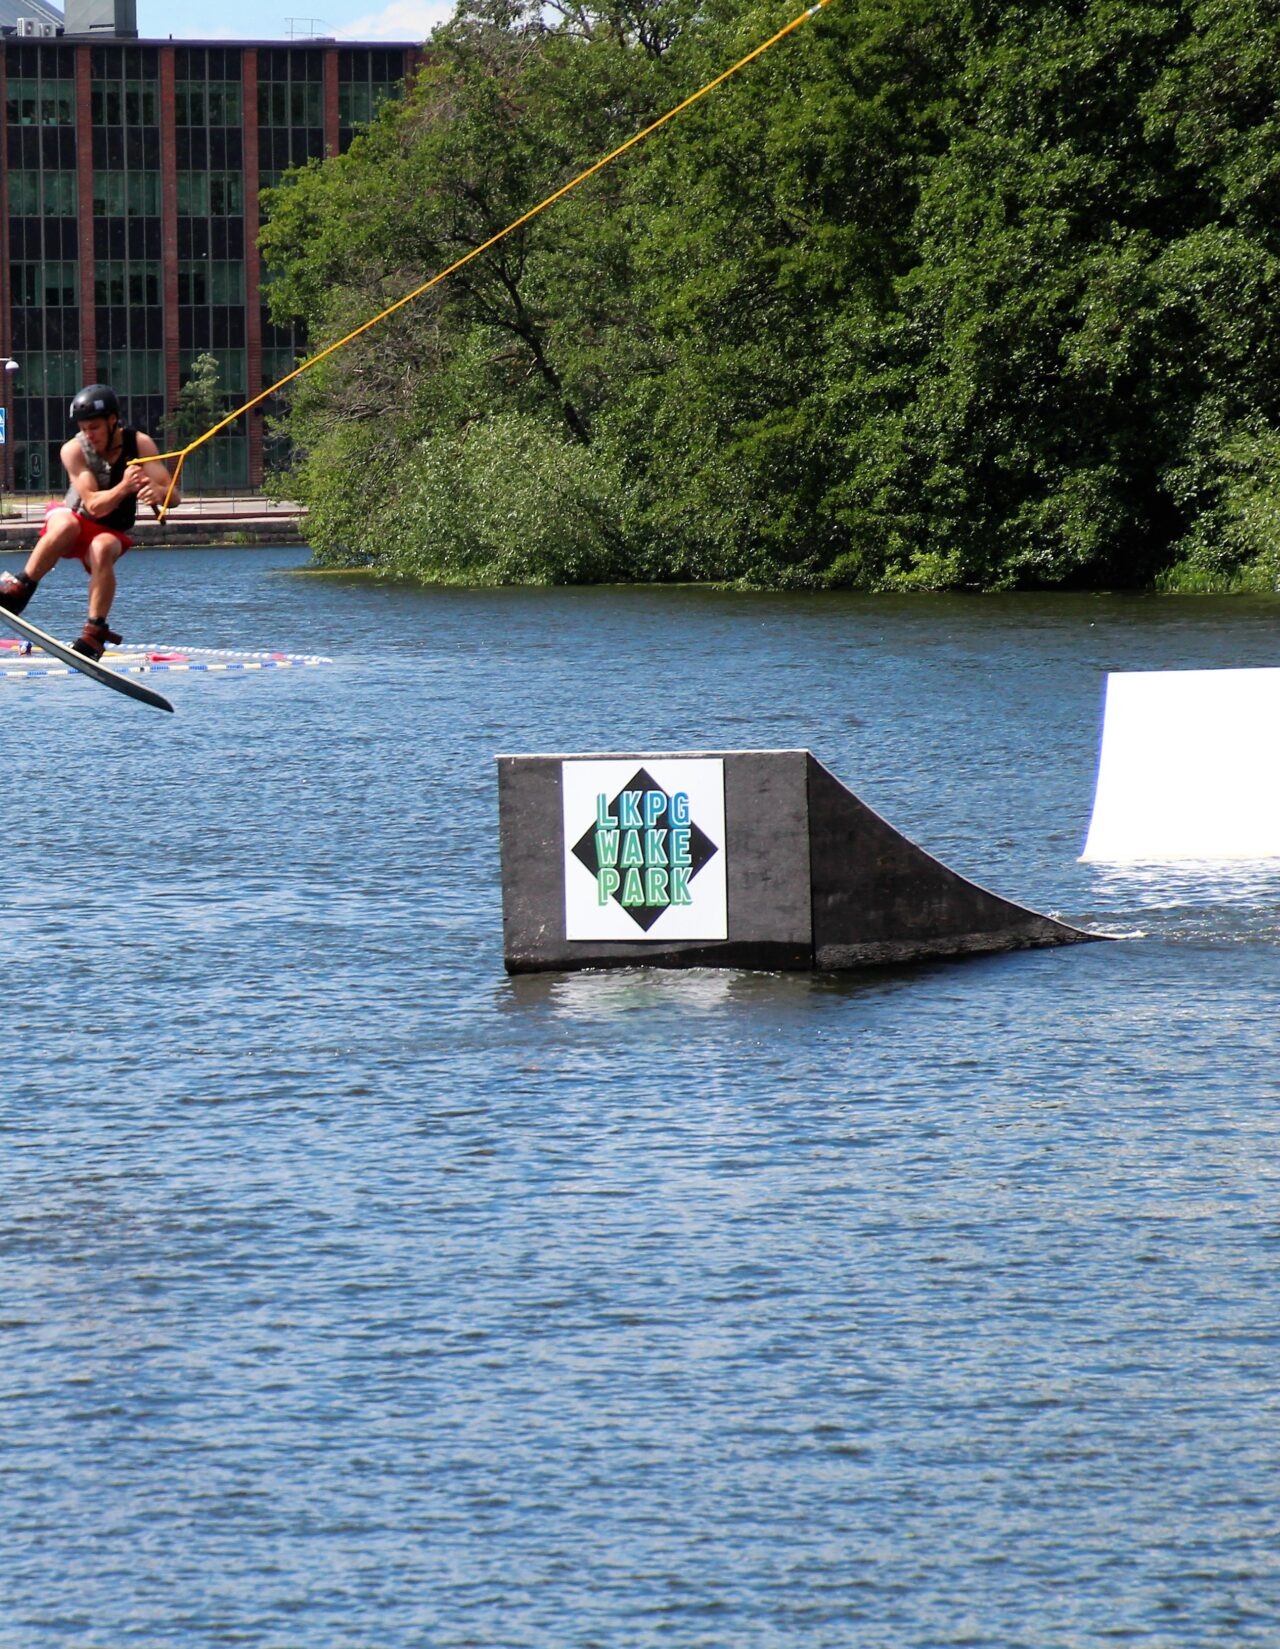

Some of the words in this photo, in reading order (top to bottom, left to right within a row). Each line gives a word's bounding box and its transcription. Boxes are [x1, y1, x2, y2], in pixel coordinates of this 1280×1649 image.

[596, 790, 691, 829] LKPG
[594, 828, 692, 868] WAKE
[597, 867, 693, 907] PARK
